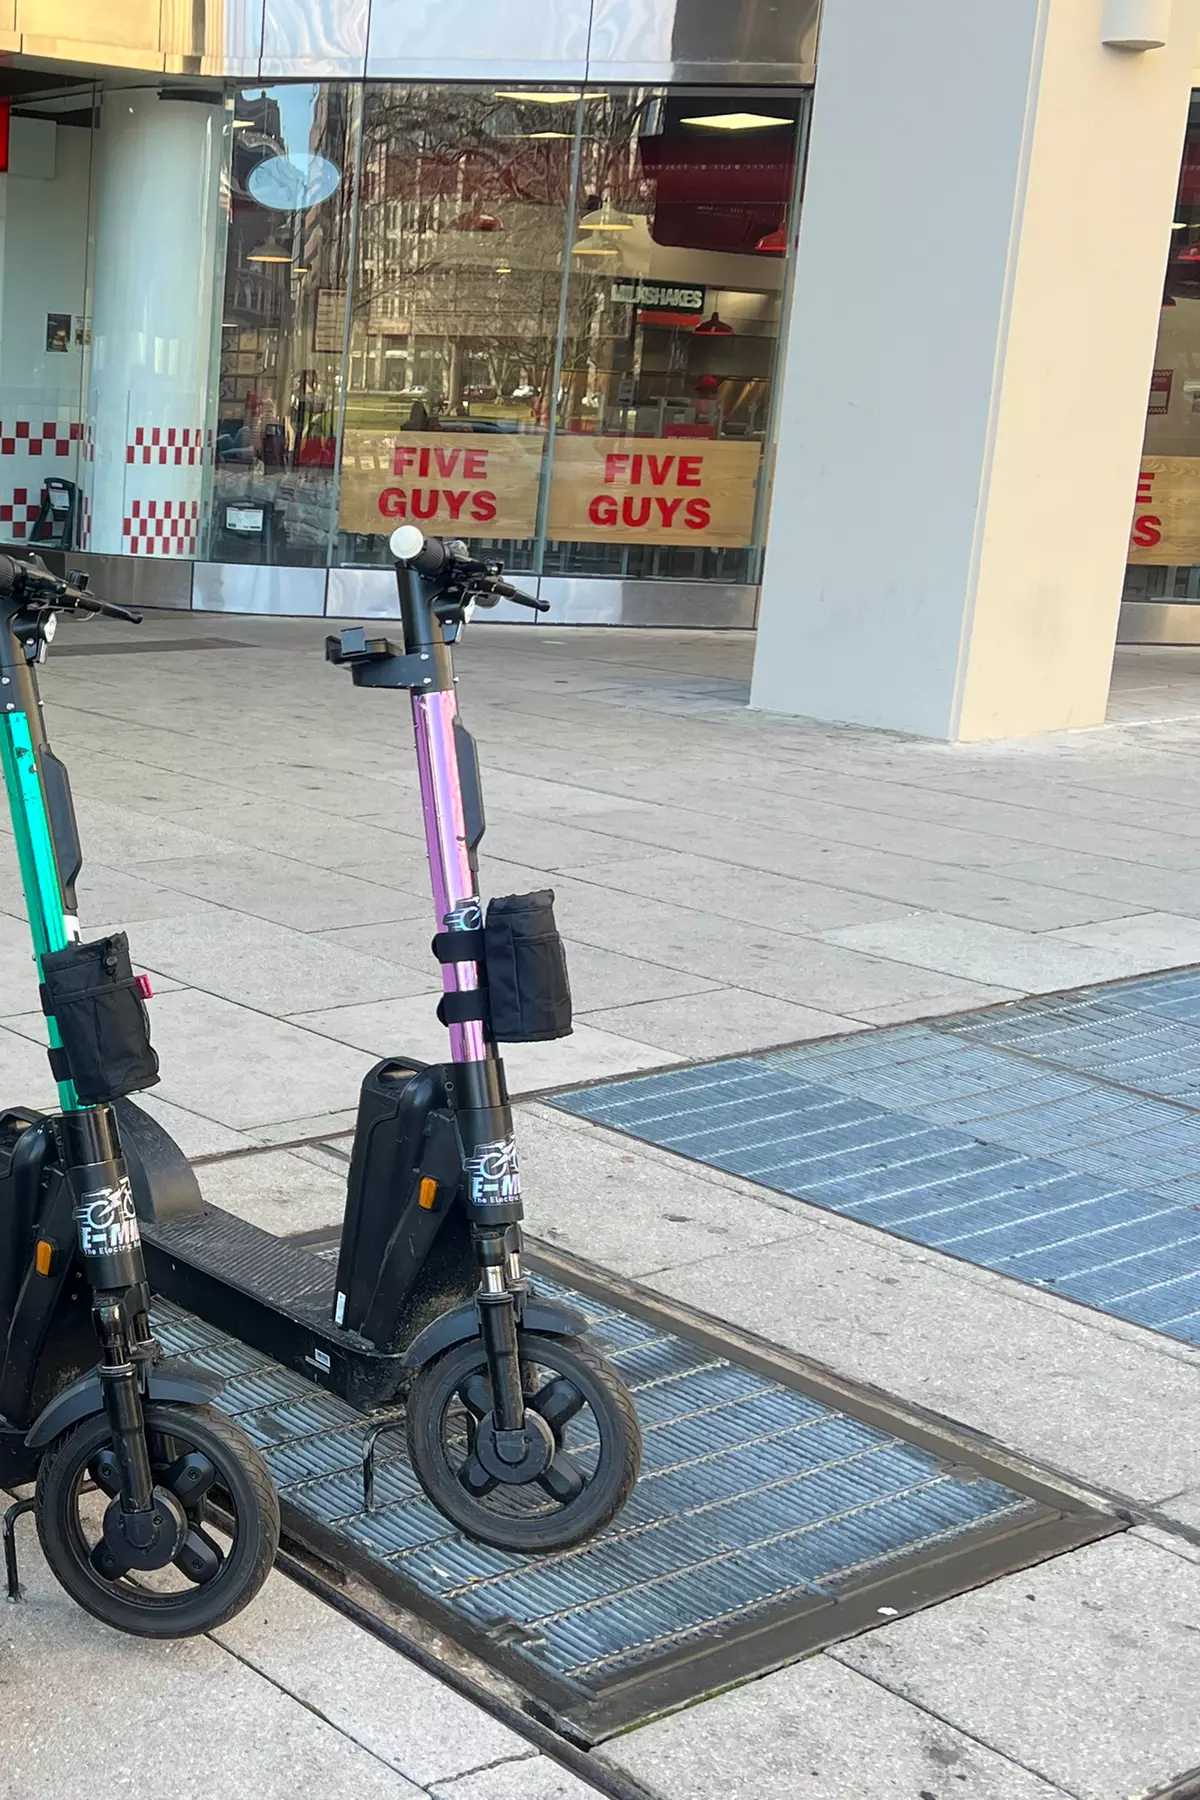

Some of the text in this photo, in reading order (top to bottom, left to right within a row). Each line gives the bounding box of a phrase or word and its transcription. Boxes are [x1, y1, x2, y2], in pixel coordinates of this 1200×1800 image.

[611, 284, 702, 309] MILKSHAKES
[393, 446, 489, 480] FIVE
[604, 453, 704, 487] FIVE
[378, 487, 497, 521] GUYS
[1135, 472, 1155, 503] E
[588, 494, 711, 530] GUYS
[1132, 515, 1162, 547] S
